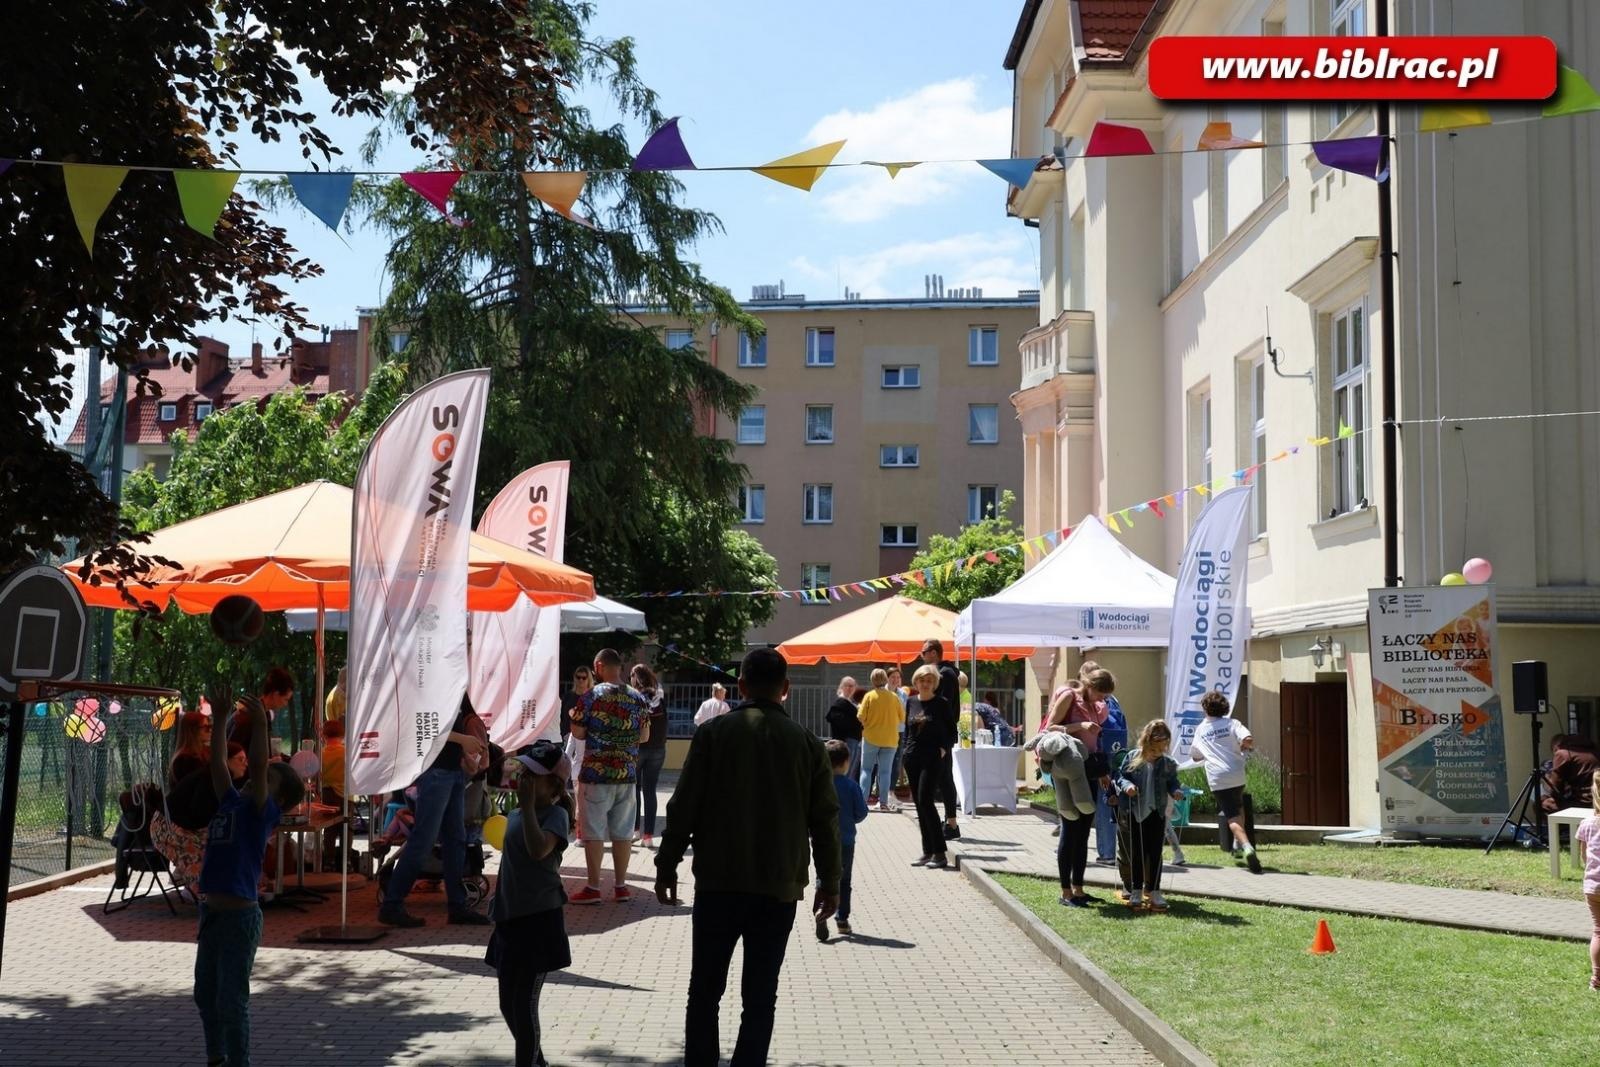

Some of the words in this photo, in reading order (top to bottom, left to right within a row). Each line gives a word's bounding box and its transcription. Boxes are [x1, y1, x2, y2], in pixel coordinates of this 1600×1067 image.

[425, 404, 459, 519] SOWA
[1098, 612, 1150, 624] Wodociągi
[1099, 623, 1151, 631] Raciborskie
[1189, 551, 1216, 698] Wodociągi
[1213, 550, 1233, 695] Raciborskie
[1381, 633, 1437, 648] ŁĄCZY
[1443, 632, 1477, 645] NAS
[1383, 648, 1489, 663] BIBLIOTEKA
[415, 712, 425, 758] KOPERNIK
[423, 712, 431, 740] NAUKI
